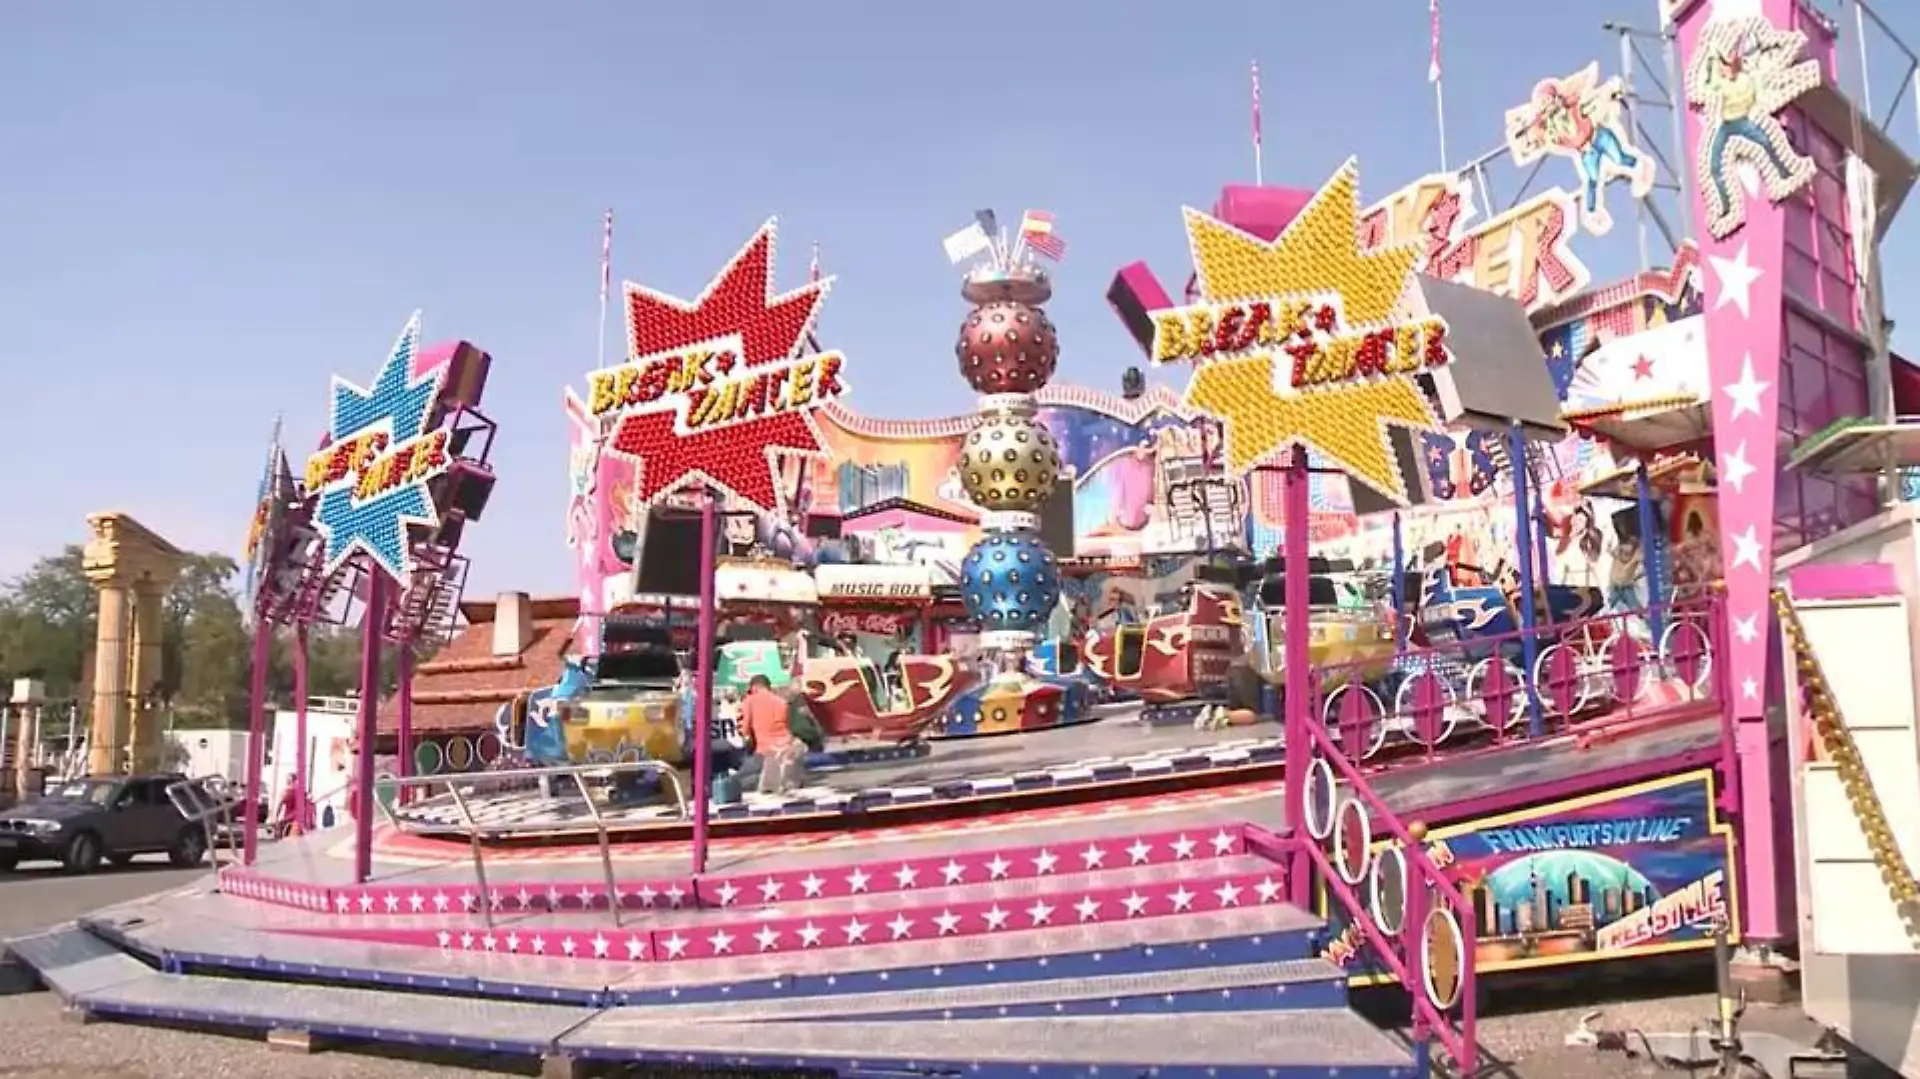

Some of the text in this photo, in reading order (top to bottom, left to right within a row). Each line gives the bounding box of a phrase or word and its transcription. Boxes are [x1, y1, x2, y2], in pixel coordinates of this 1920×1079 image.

[1157, 299, 1313, 363] BREAK
[591, 350, 715, 416] BREAK
[686, 354, 844, 428] DANCER
[830, 583, 922, 596] MUSIC BOX
[1482, 823, 1599, 854] FRANKFURT
